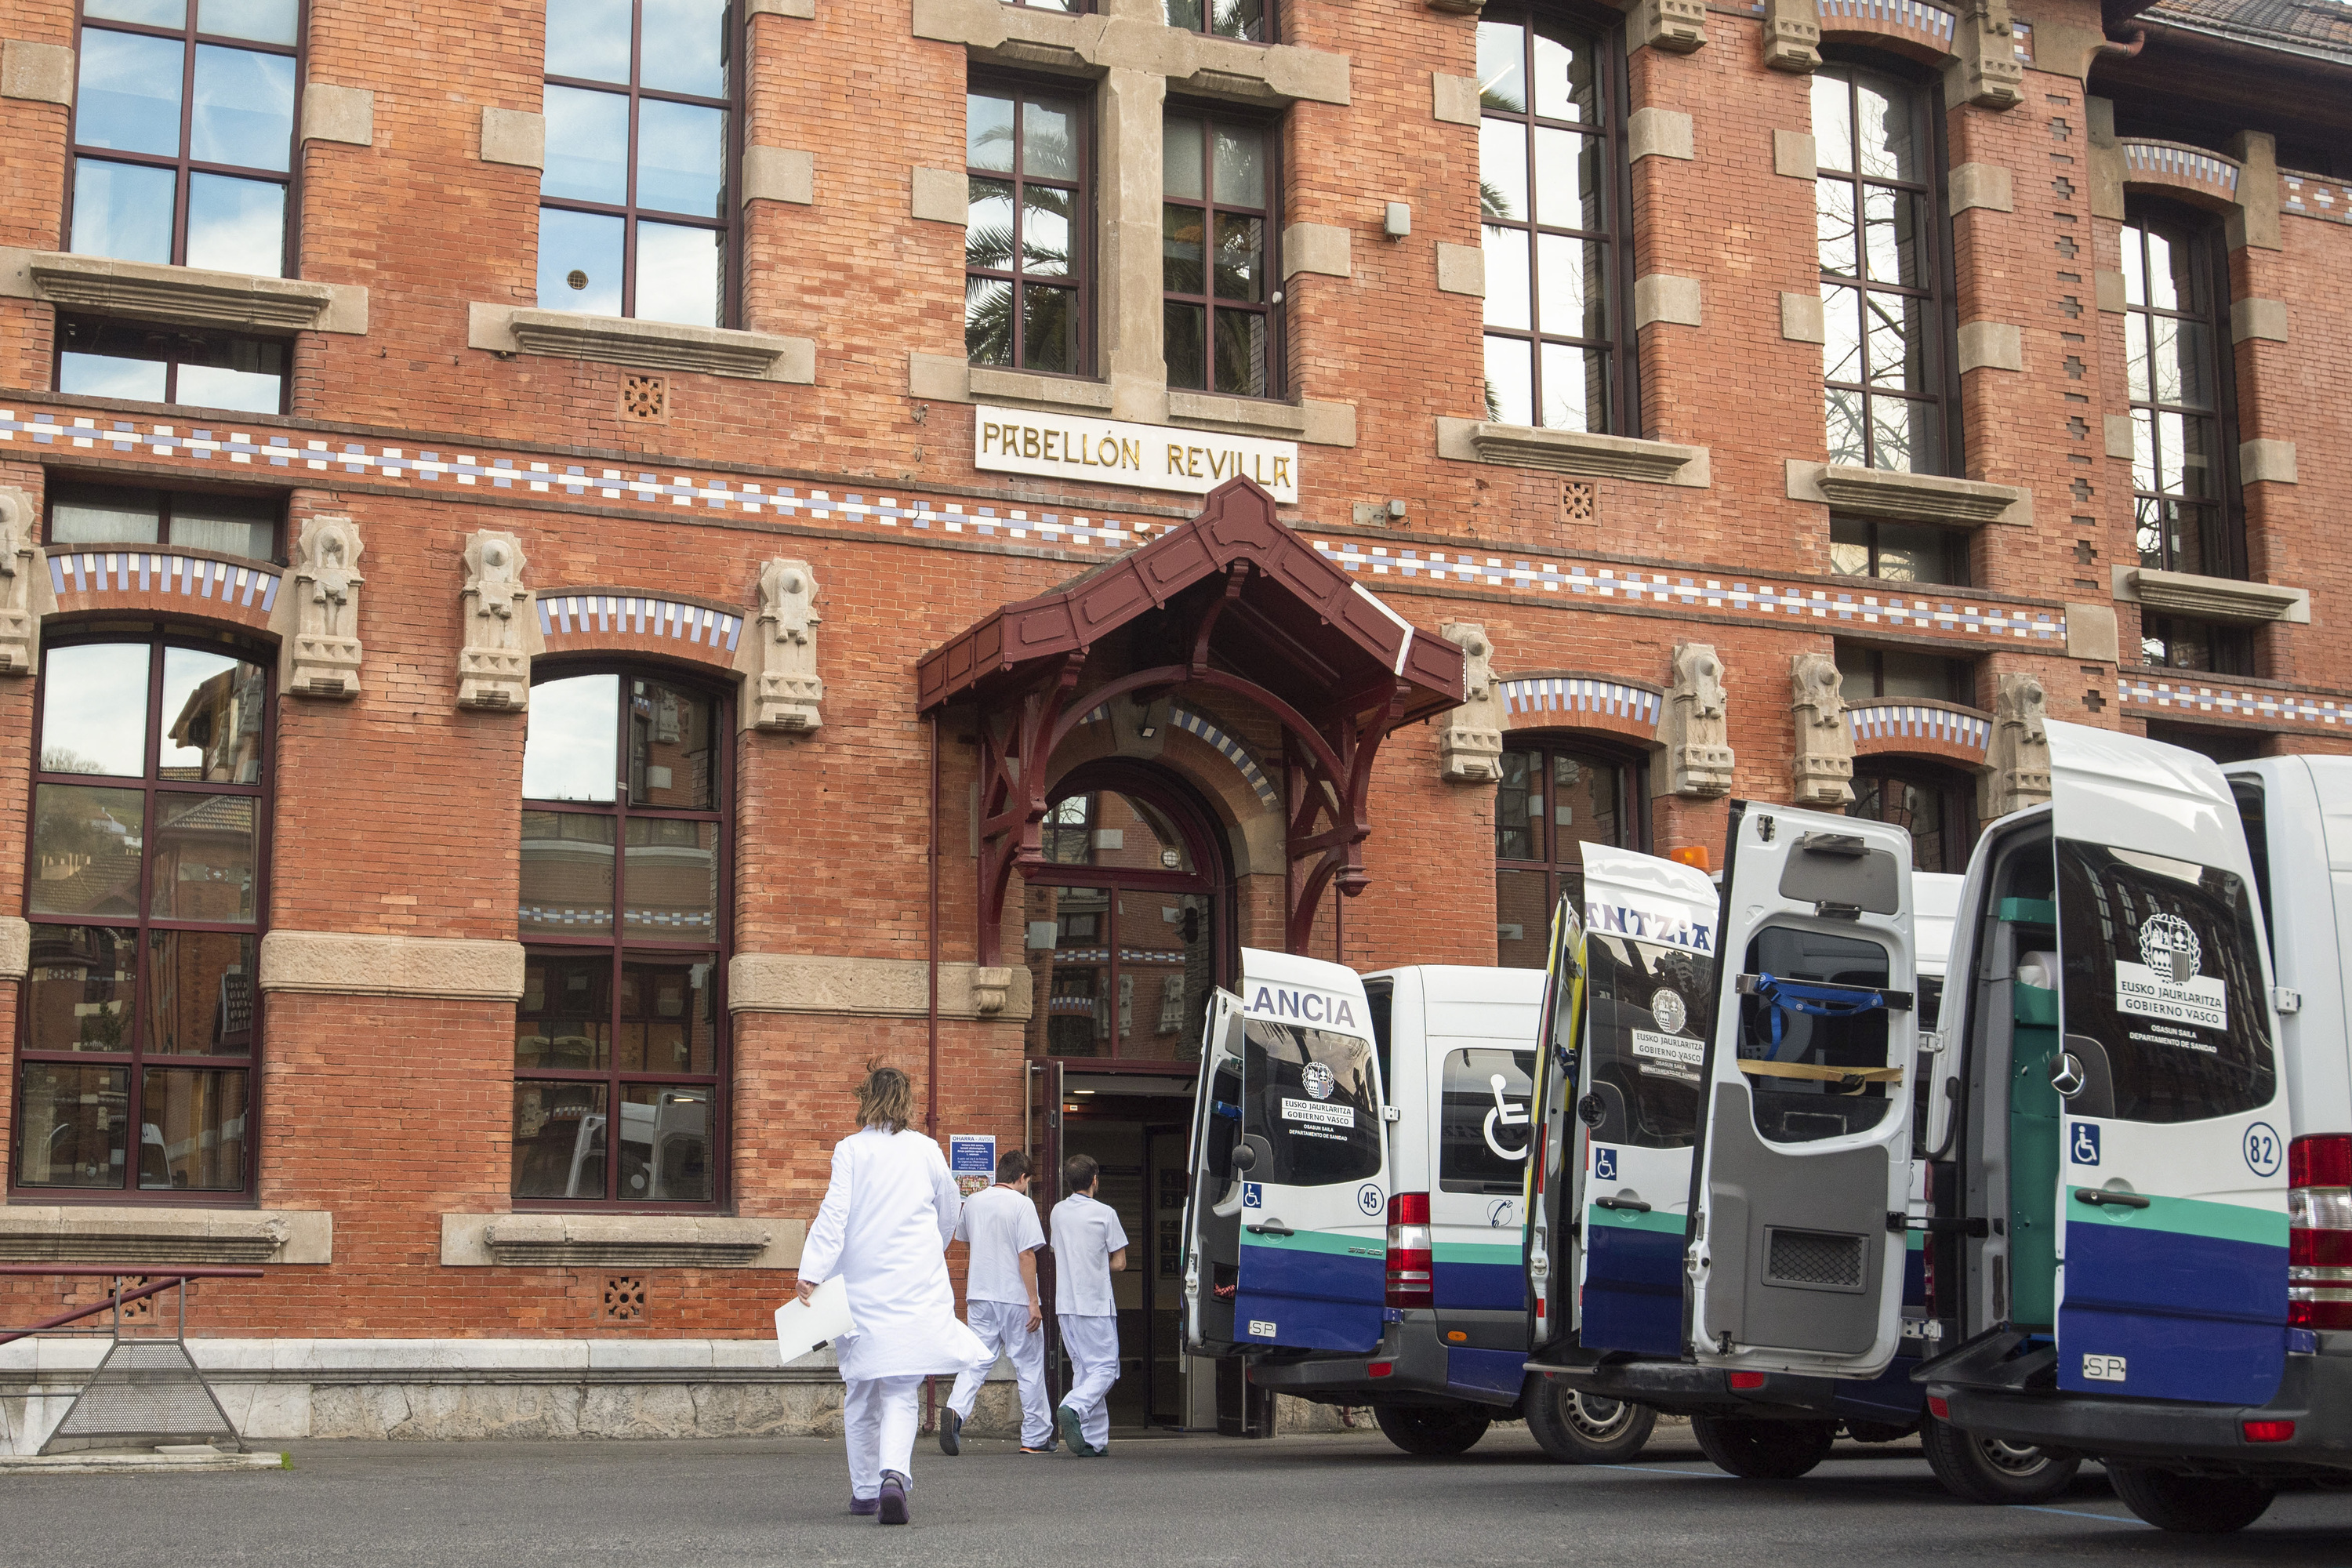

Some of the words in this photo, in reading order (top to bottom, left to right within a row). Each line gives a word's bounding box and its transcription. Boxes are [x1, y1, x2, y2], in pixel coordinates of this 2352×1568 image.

[982, 421, 1140, 470] PABELLÓN
[2121, 981, 2155, 995] EUSKO
[2158, 987, 2222, 1007] JAURLARITZA
[1244, 986, 1356, 1028] ANCIA
[2125, 999, 2183, 1017] GOBIERNO
[2185, 1009, 2219, 1023] VASCO
[2151, 1025, 2177, 1035] OSASUN
[2178, 1029, 2197, 1039] SAILA
[1636, 1033, 1659, 1043] EUSKO
[1661, 1037, 1703, 1051] JAURLARITZA
[2129, 1032, 2180, 1047] DEPARTAMENTO
[2190, 1042, 2217, 1053] SANIDAD
[1639, 1044, 1677, 1058] GOBIERNO
[1678, 1051, 1700, 1062] VASCO
[1285, 1100, 1307, 1109] EUSKO
[1308, 1104, 1352, 1115] JAURLARITZA
[1287, 1111, 1325, 1121] GOBIERNO
[1327, 1116, 1349, 1125] VASCO
[1289, 1129, 1323, 1138] DEPARTAMENTO
[2250, 1135, 2273, 1164] 82
[1363, 1192, 1377, 1208] 45
[1252, 1322, 1273, 1334] SP
[2089, 1357, 2122, 1377] SP
